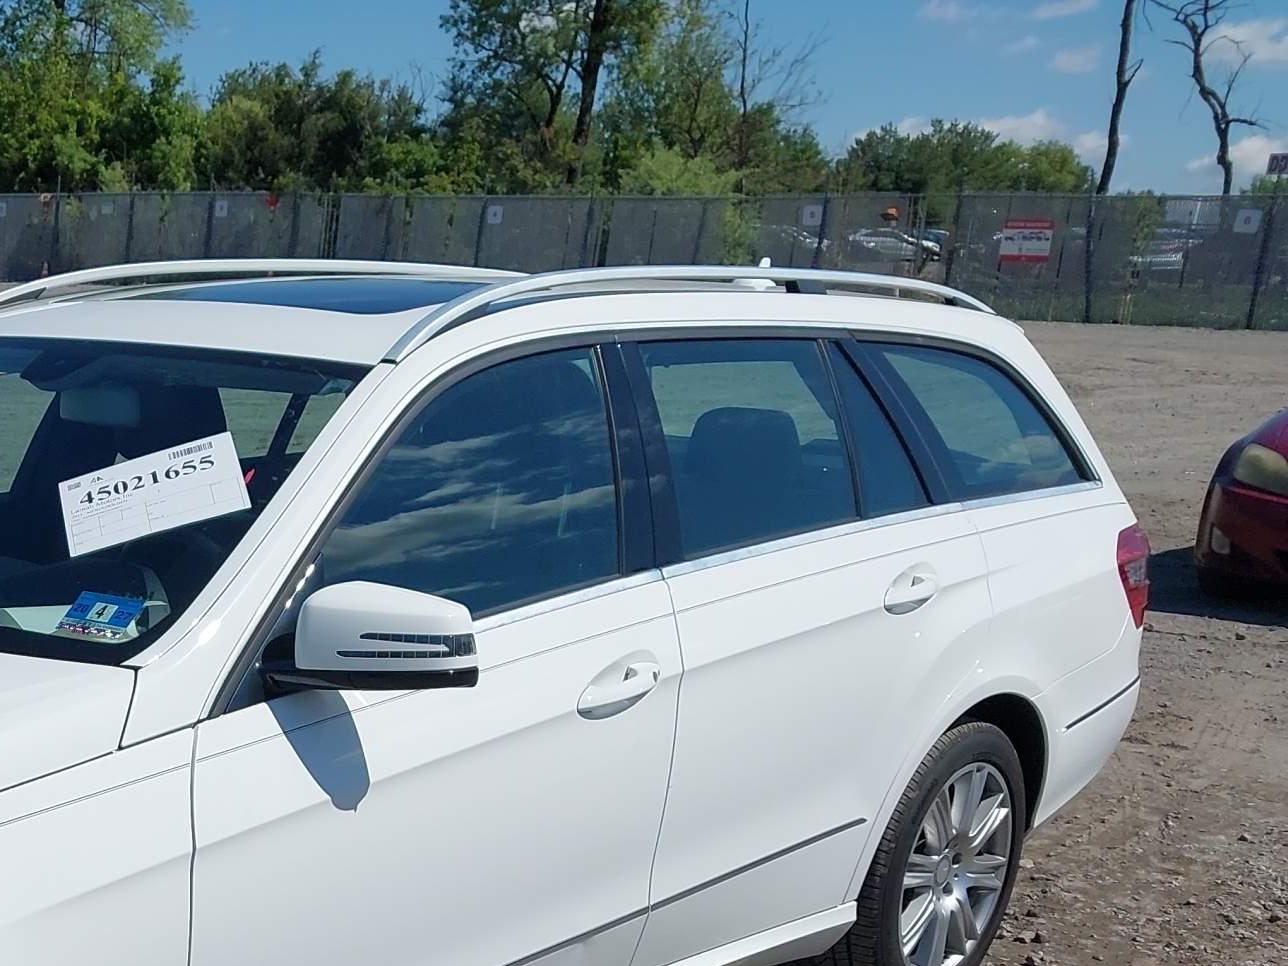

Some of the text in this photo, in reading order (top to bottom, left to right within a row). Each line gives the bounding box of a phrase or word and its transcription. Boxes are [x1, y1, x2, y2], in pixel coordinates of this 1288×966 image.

[79, 455, 215, 506] 45021655
[74, 603, 90, 613] 20
[95, 604, 109, 619] 4
